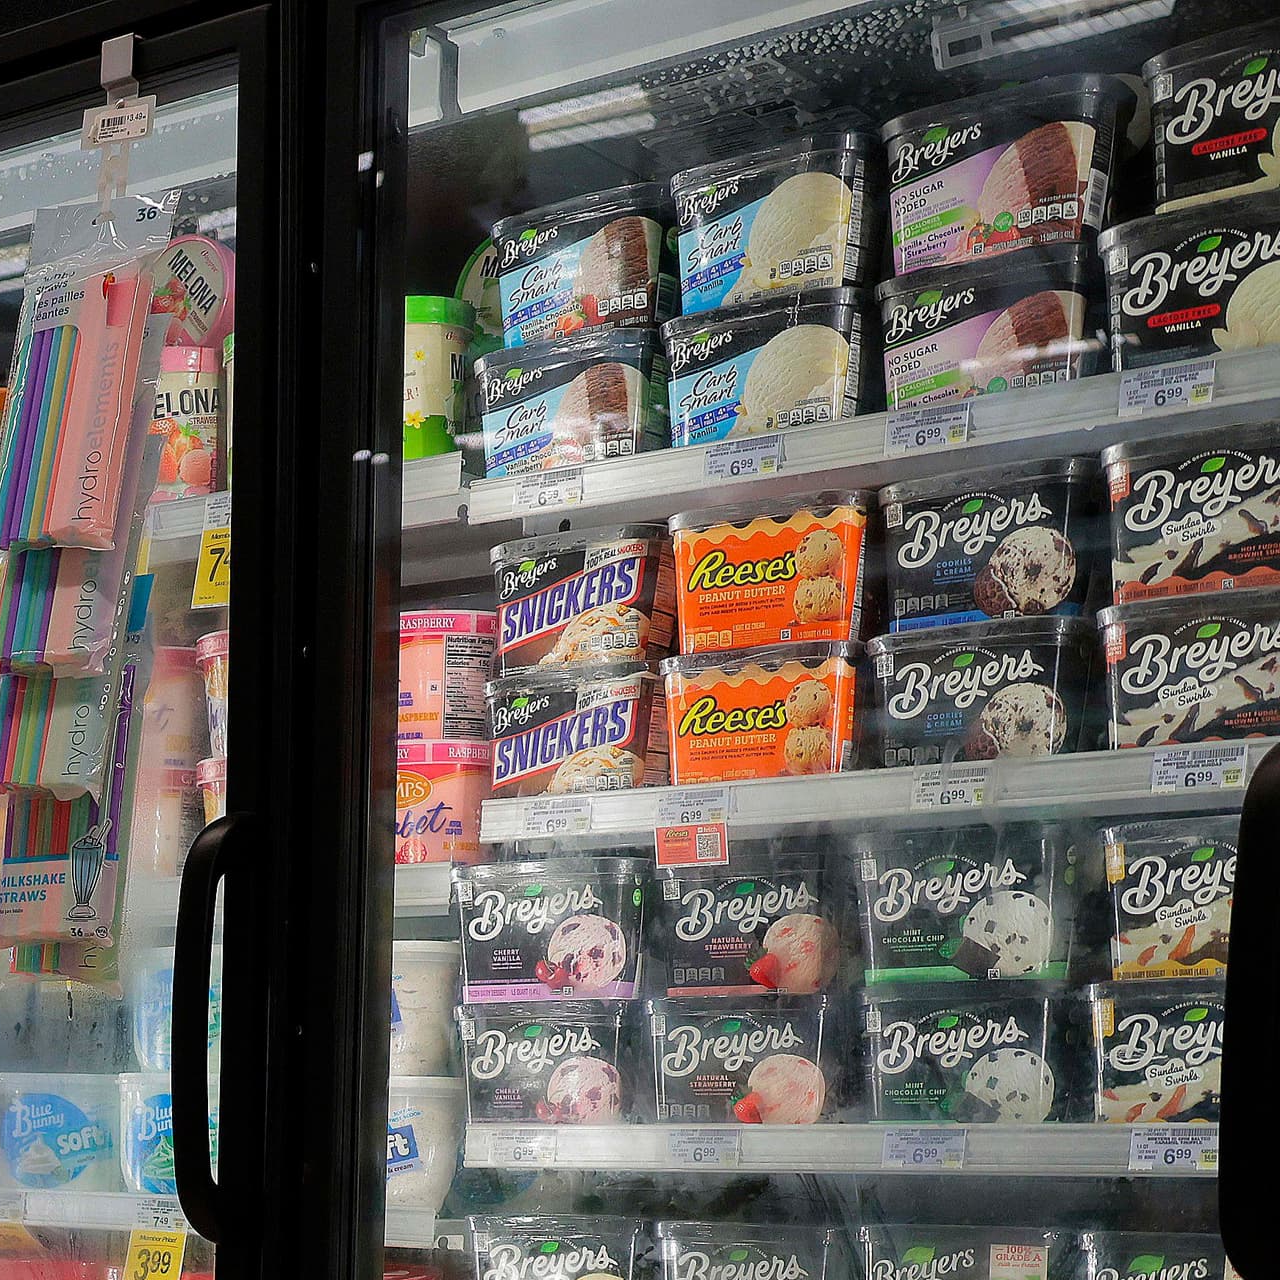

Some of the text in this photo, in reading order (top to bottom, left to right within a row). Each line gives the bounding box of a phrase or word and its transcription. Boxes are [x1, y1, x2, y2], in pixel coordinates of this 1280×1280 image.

[892, 121, 982, 184] Breyers
[1210, 145, 1248, 161] VANILLA
[680, 180, 739, 225] Breyers
[894, 181, 944, 207] NO SUGAR
[136, 207, 157, 221] 36
[895, 198, 926, 218] ADDED
[701, 216, 743, 246] Carb
[928, 225, 965, 242] Chocolate
[501, 226, 559, 269] Breyers
[688, 235, 739, 273] Smart
[907, 241, 948, 258] Strawberry
[168, 249, 218, 315] MELONA
[521, 260, 563, 290] Carb
[698, 279, 723, 293] Vanilla
[51, 291, 84, 307] pailles
[510, 276, 560, 311] Smart
[886, 287, 975, 344] Breyers
[1165, 321, 1201, 333] VANILLA
[521, 320, 559, 339] Strawberry
[671, 330, 733, 373] Breyers
[888, 344, 938, 368] NO SUGAR
[693, 364, 738, 397] Carb
[890, 361, 921, 378] ADDED
[487, 366, 543, 405] Breyers
[922, 388, 959, 404] Chocolate
[153, 388, 219, 419] ELONA
[679, 380, 736, 419] Smart
[507, 402, 547, 429] Carb
[494, 417, 546, 449] Smart
[691, 427, 718, 440] Vanilla
[898, 493, 1052, 568] Breyers
[1166, 518, 1201, 536] Sundae
[1182, 522, 1216, 542] Swirls
[688, 551, 796, 591] Reese's
[937, 559, 972, 568] COOKIES
[944, 567, 971, 575] CREAM
[500, 557, 557, 600] Breyers
[503, 558, 635, 644] SNICKERS
[699, 585, 785, 603] PEANUT BUTTER
[888, 650, 1044, 719] Breyers
[1162, 683, 1197, 699] Sundae
[1178, 690, 1214, 706] Swirls
[494, 696, 549, 735] Breyers
[679, 697, 786, 736] Reese's
[927, 712, 963, 720] COOKIES
[62, 704, 89, 776] hydro
[496, 700, 628, 780] SNICKERS
[690, 734, 776, 749] PEANUT BUTTER
[0, 890, 46, 904] STRAWS
[874, 858, 1027, 921] Breyers
[469, 885, 603, 941] Breyers
[676, 882, 819, 941] Breyers
[1160, 905, 1192, 920] Sundae
[1175, 912, 1207, 928] Swirls
[71, 927, 82, 937] 36
[882, 936, 924, 944] CHOCOLATE
[471, 1027, 600, 1079] Breyers
[662, 1023, 804, 1076] Breyers
[877, 1016, 1029, 1074] Breyers
[1150, 1064, 1183, 1078] Sundae
[1165, 1071, 1199, 1086] Swirls
[57, 1125, 104, 1156] soft
[996, 1253, 1030, 1262] GRADE
